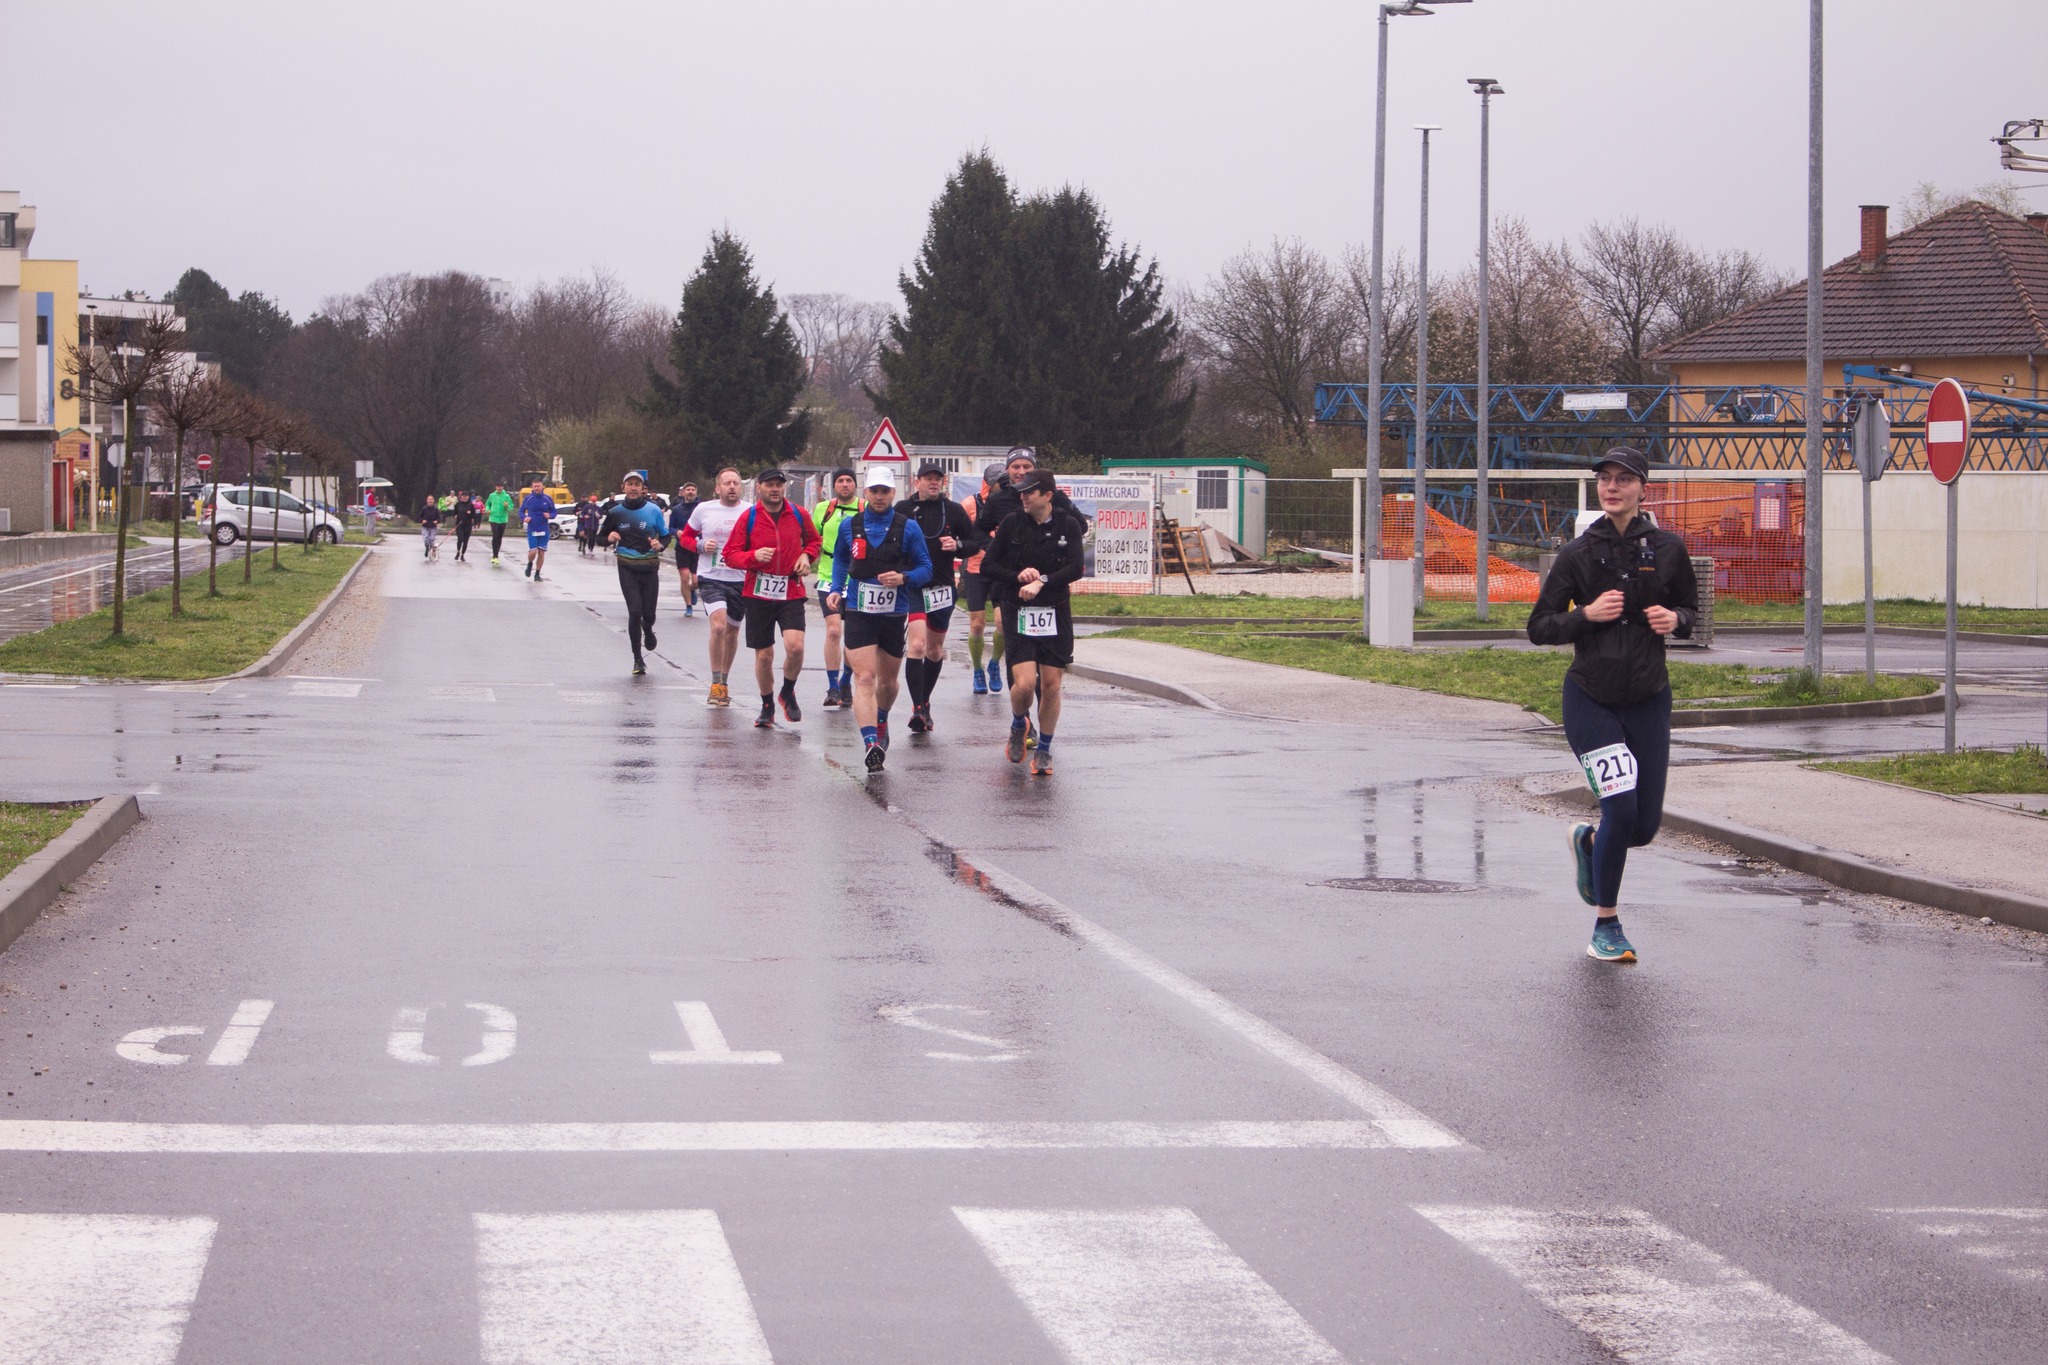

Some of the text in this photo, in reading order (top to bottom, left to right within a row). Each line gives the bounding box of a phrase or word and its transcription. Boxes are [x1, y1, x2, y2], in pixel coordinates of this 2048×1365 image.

[60, 378, 74, 400] 8
[1073, 486, 1140, 499] INTERMEGRAD
[1097, 510, 1148, 530] PRODAJA
[1096, 539, 1149, 555] 098/241 084
[1096, 559, 1148, 575] 098/426 370
[764, 579, 786, 593] 172
[868, 590, 895, 606] 169
[931, 588, 951, 604] 171
[1029, 612, 1054, 628] 167
[1597, 752, 1633, 783] 217
